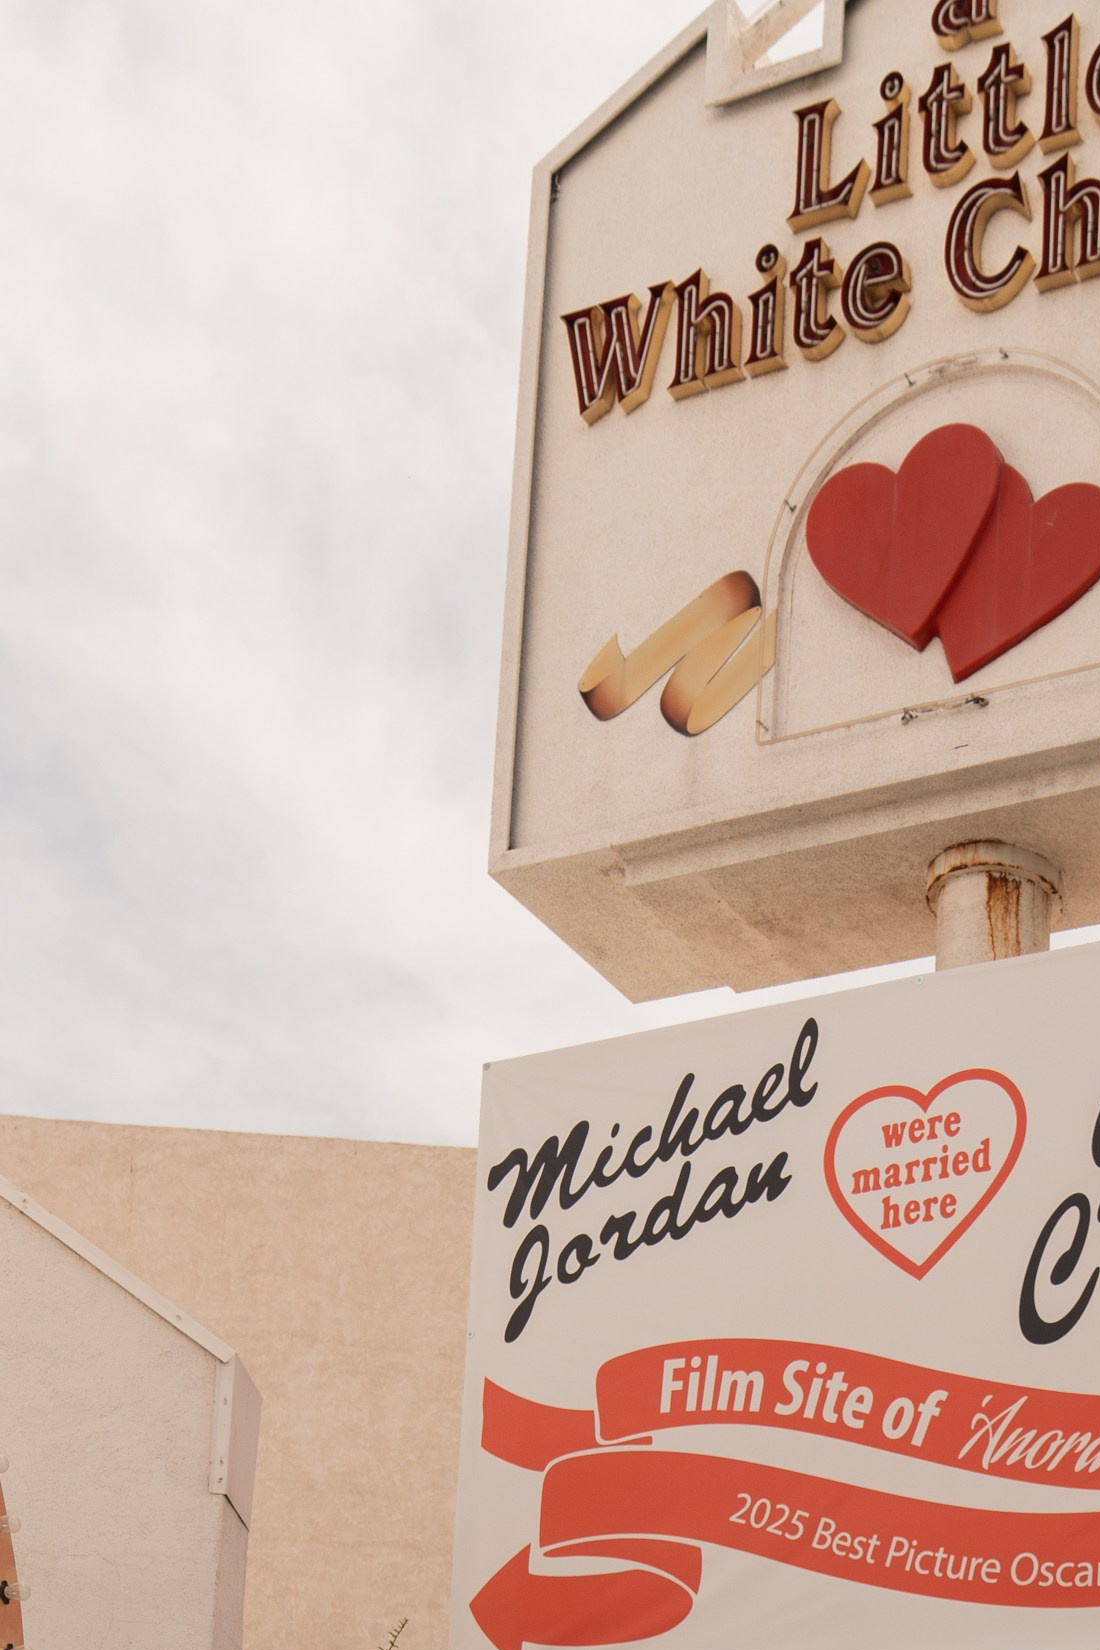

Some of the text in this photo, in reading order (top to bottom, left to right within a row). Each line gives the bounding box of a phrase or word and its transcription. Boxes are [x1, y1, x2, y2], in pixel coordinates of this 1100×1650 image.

[560, 238, 911, 425] White
[486, 1016, 819, 1229] Michael
[850, 1137, 992, 1195] married
[881, 1110, 962, 1149] were
[503, 1150, 793, 1344] Jordan
[879, 1192, 957, 1230] here
[659, 1354, 765, 1414] Film
[773, 1359, 874, 1430] Site
[881, 1389, 950, 1448] of
[728, 1492, 811, 1541] 2025
[811, 1516, 880, 1565] Best
[884, 1535, 1001, 1585] Picture
